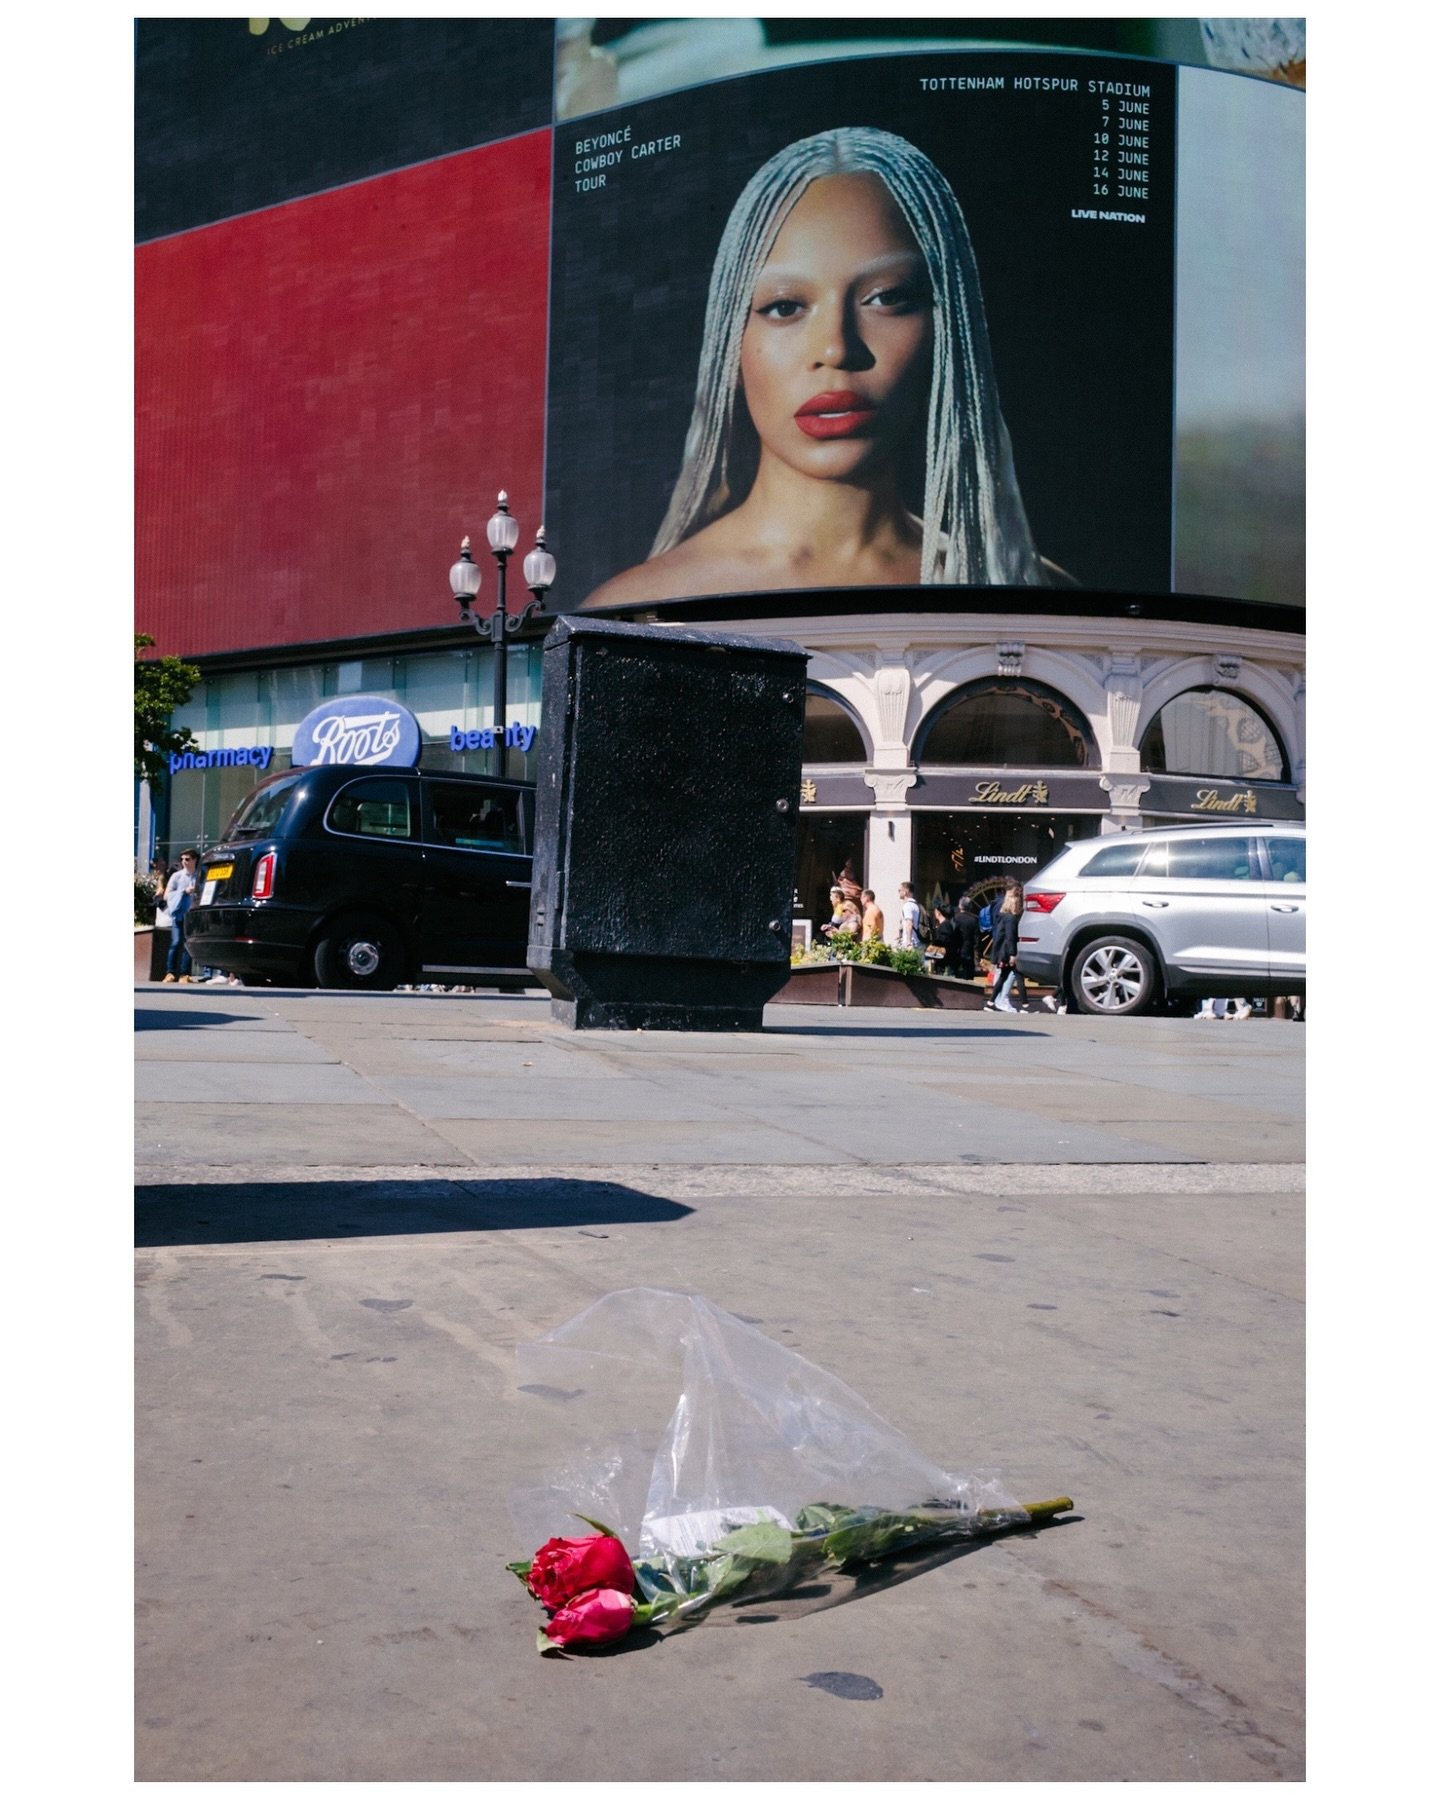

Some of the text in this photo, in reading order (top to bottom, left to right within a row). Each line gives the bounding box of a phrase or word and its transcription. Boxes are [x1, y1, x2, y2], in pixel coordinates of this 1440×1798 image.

[267, 43, 284, 55] ICE
[287, 30, 324, 49] CREAM
[919, 77, 1151, 97] TOTTENHAM HOTSPUR STADIUM
[1102, 99, 1150, 114] 5 JUNE
[1102, 116, 1150, 131] 7 JUNE
[575, 125, 632, 155] BEYONCÉ
[1094, 133, 1150, 148] 10 JUNE
[574, 134, 681, 174] COWBOY CARTER
[1094, 150, 1149, 165] 12 JUNE
[1093, 167, 1149, 182] 14 JUNE
[574, 174, 606, 192] TOUR
[1093, 184, 1149, 199] 16 JUNE
[1071, 208, 1146, 224] LIVE NATION
[968, 781, 1034, 803] Lindt
[1190, 789, 1245, 811] Lindt
[974, 855, 1038, 864] #LINDTLONDON
